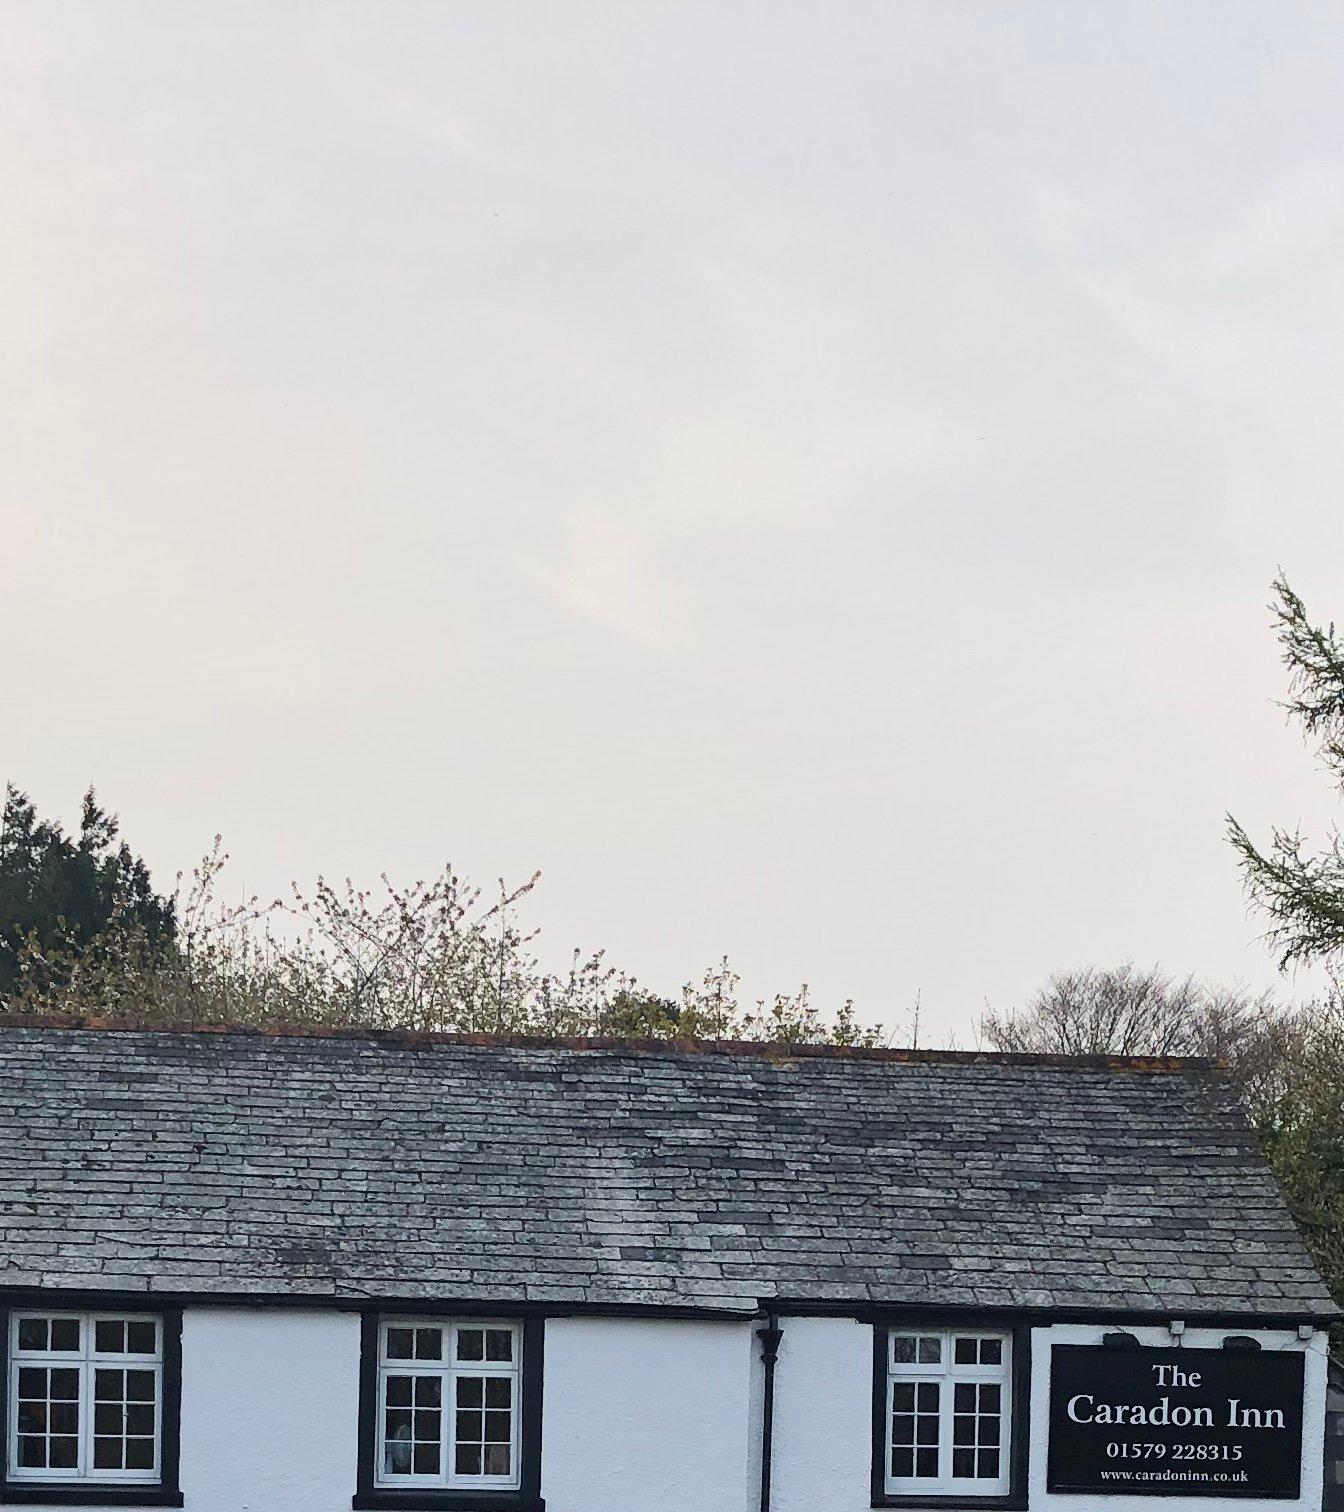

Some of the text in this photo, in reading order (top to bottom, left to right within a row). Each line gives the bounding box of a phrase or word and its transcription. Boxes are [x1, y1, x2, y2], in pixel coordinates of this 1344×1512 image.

[1153, 1364, 1202, 1388] The
[1067, 1394, 1286, 1429] Caradon Inn
[1106, 1442, 1243, 1461] 01579 228315
[1100, 1469, 1249, 1483] www.caradoninn.co.uk
